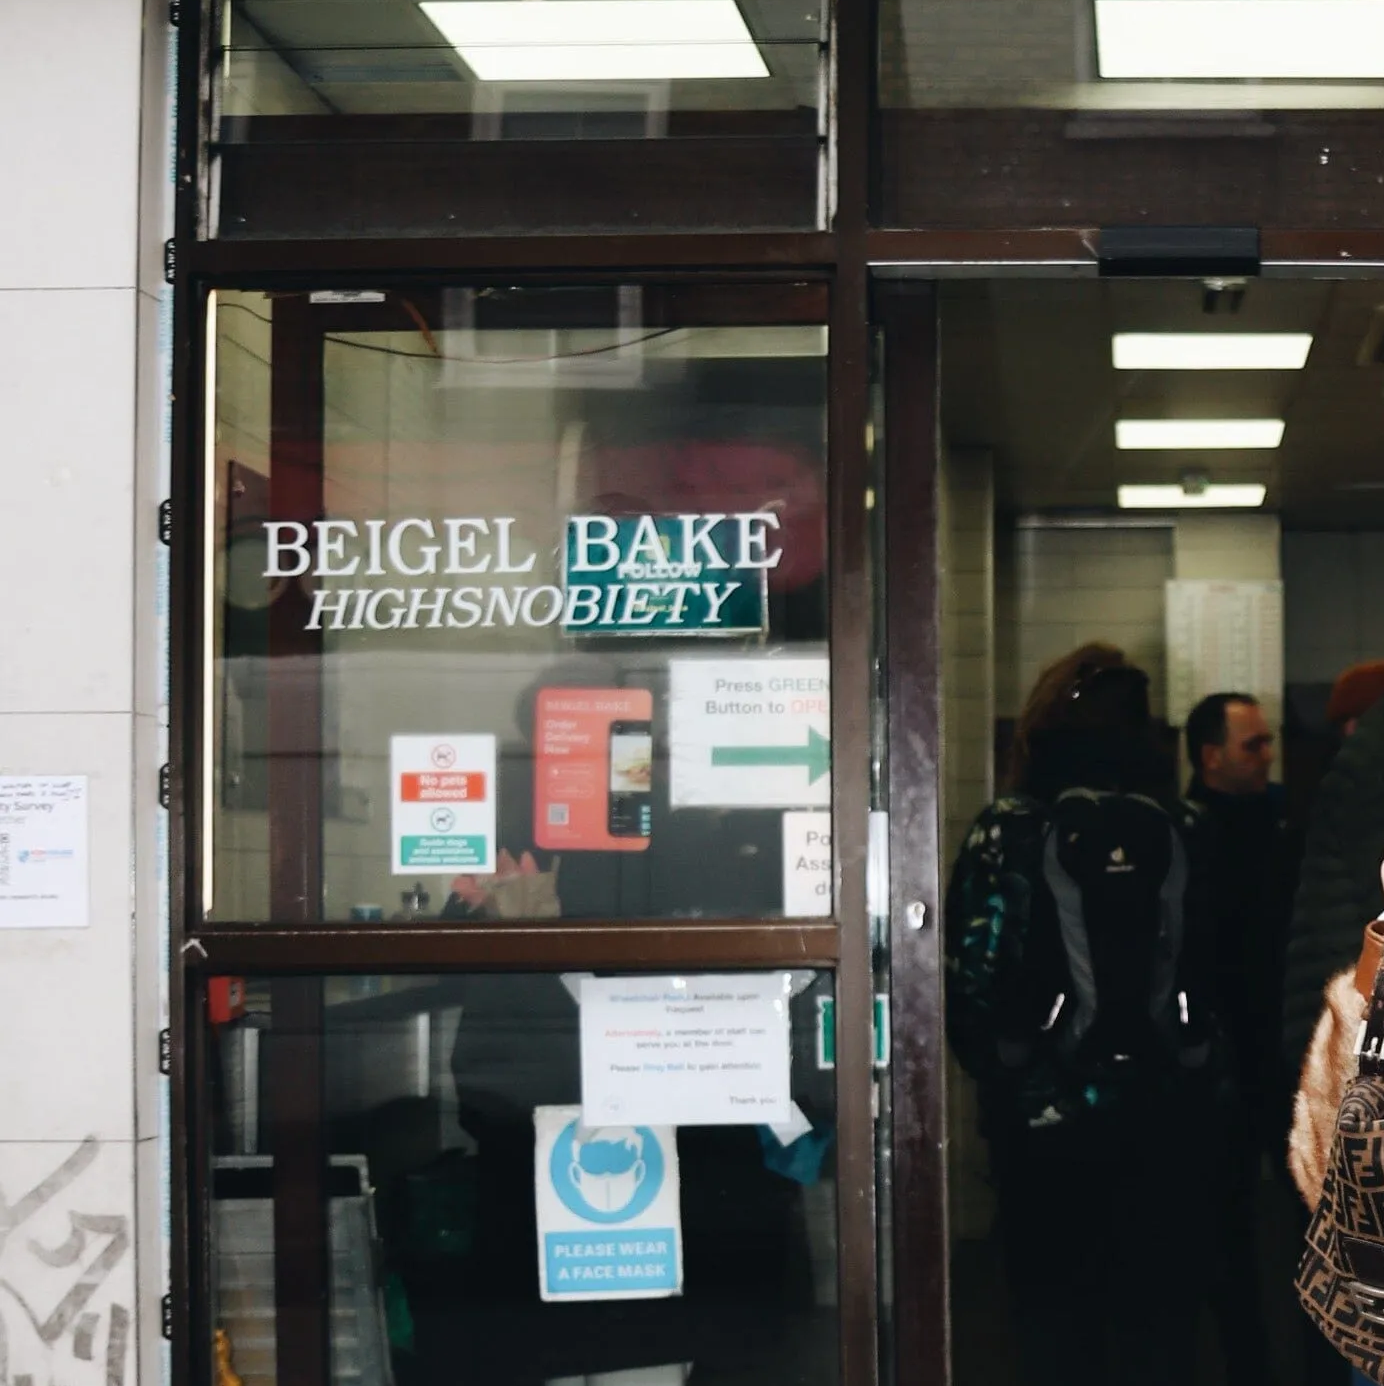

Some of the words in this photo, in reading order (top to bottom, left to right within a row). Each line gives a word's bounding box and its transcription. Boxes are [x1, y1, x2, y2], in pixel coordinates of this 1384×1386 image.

[262, 516, 537, 578] BEIGEL
[567, 512, 785, 573] BAKE
[304, 582, 742, 631] HIGHSNOBIETY
[714, 678, 764, 693] Press
[704, 700, 763, 715] Button
[768, 700, 785, 715] to
[554, 1242, 617, 1258] PLEASE
[618, 1240, 668, 1256] WEAR
[557, 1267, 571, 1281] A
[572, 1264, 615, 1280] FACE
[617, 1263, 667, 1279] MASK
